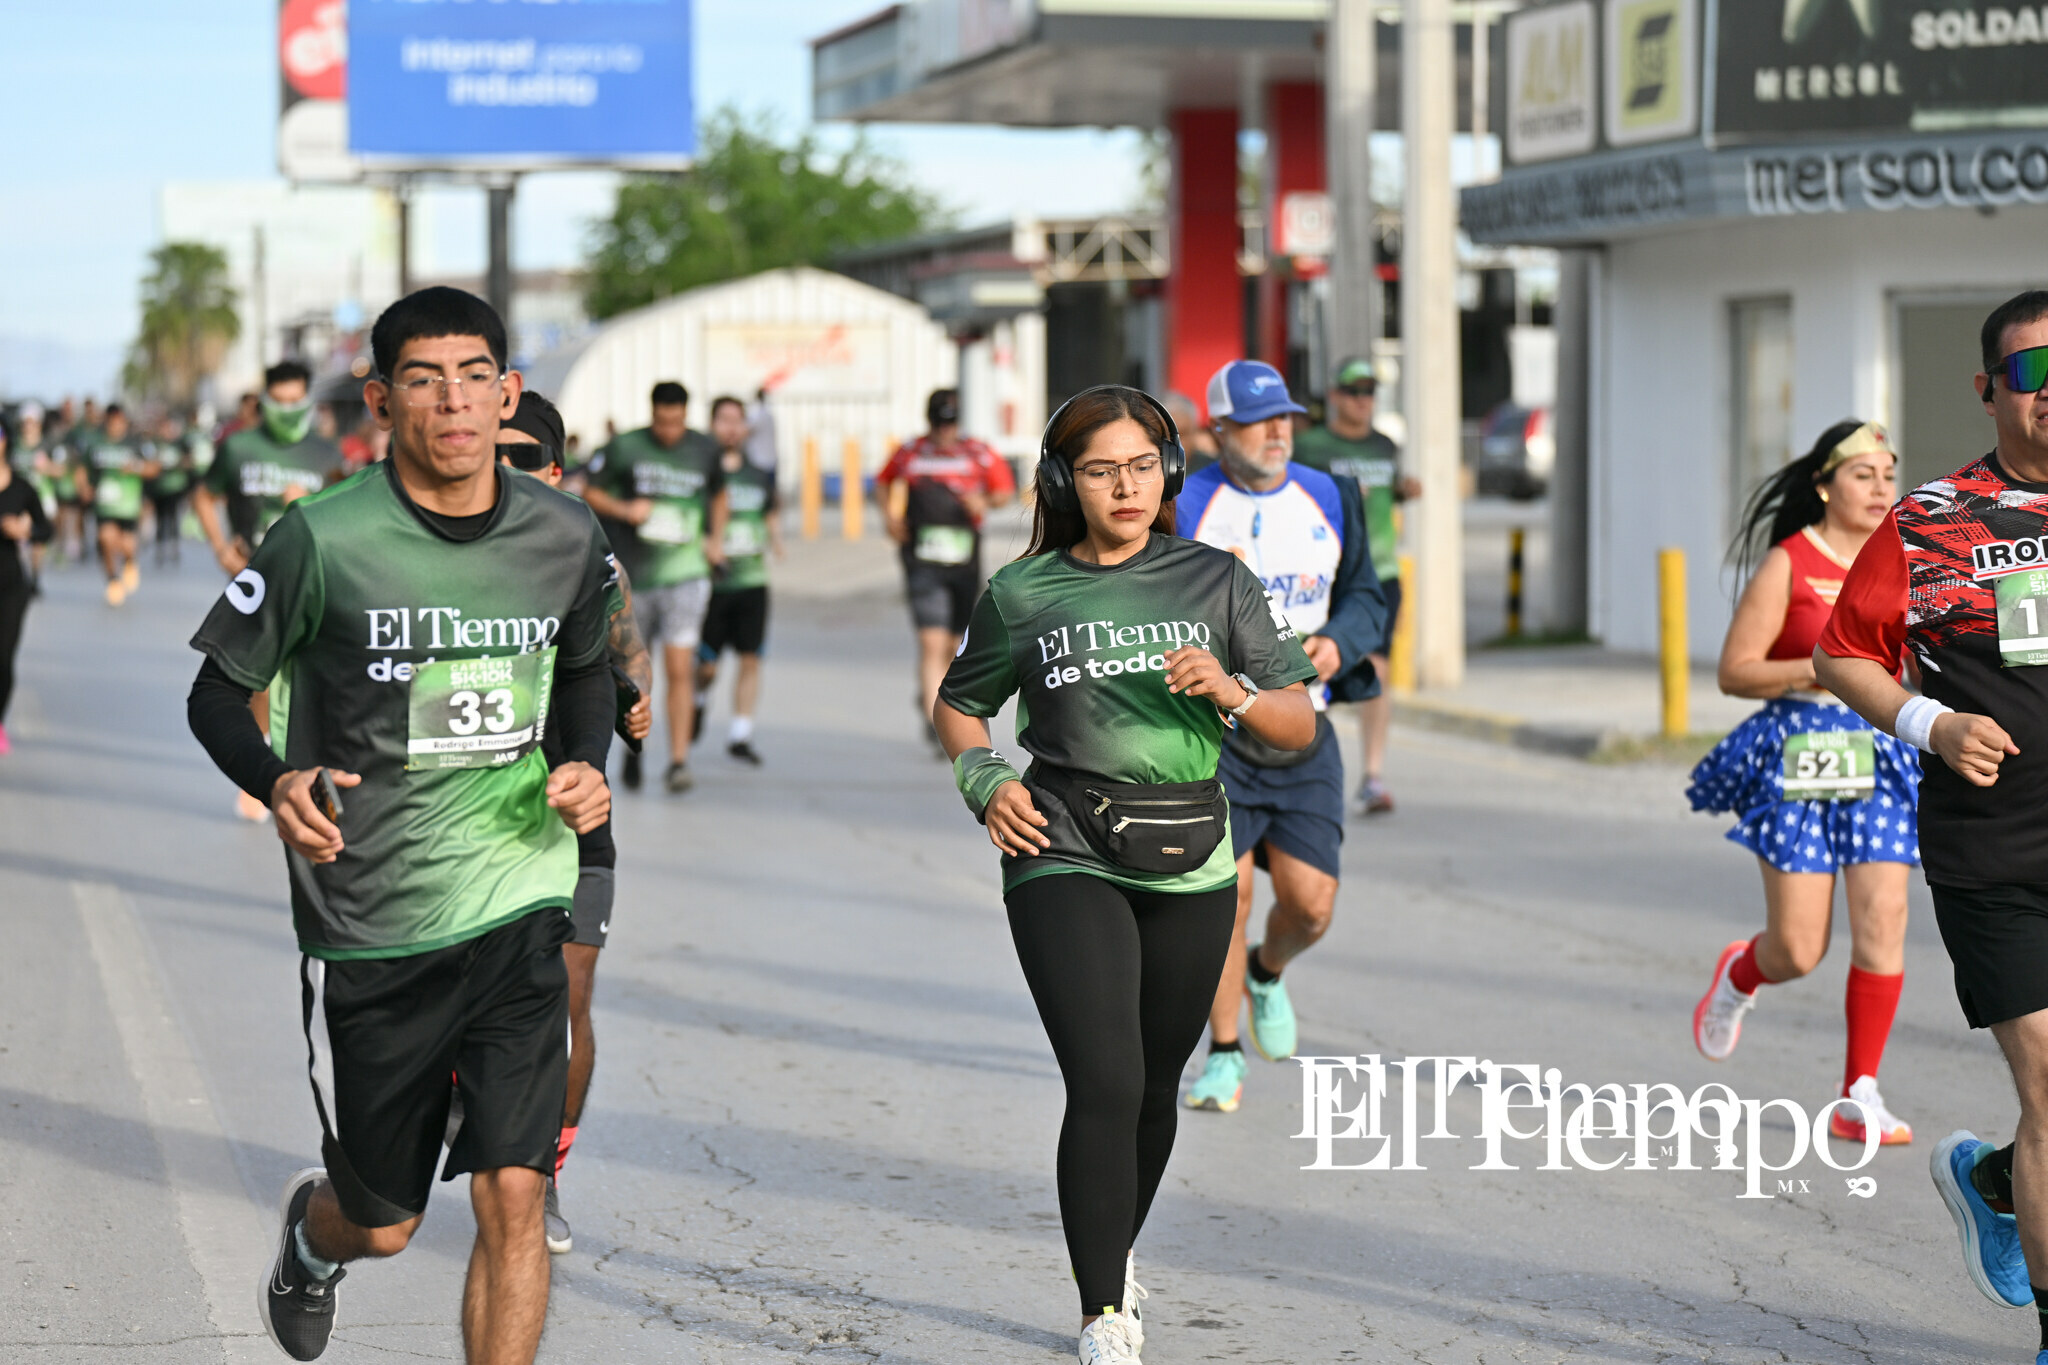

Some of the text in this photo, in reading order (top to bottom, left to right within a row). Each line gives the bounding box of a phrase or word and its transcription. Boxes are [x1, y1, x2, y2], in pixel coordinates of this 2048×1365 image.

[1911, 4, 2048, 50] SOLDA
[1754, 61, 1902, 101] MERSOL
[364, 607, 560, 655] El Tiempo
[1037, 620, 1210, 666] El Tiempo
[367, 657, 412, 682] de
[450, 660, 513, 672] CARRERA
[1045, 666, 1081, 689] de
[448, 688, 515, 735] 33
[535, 671, 551, 741] MEDALLA
[433, 741, 475, 750] Rodrigo
[1797, 750, 1857, 778] 521
